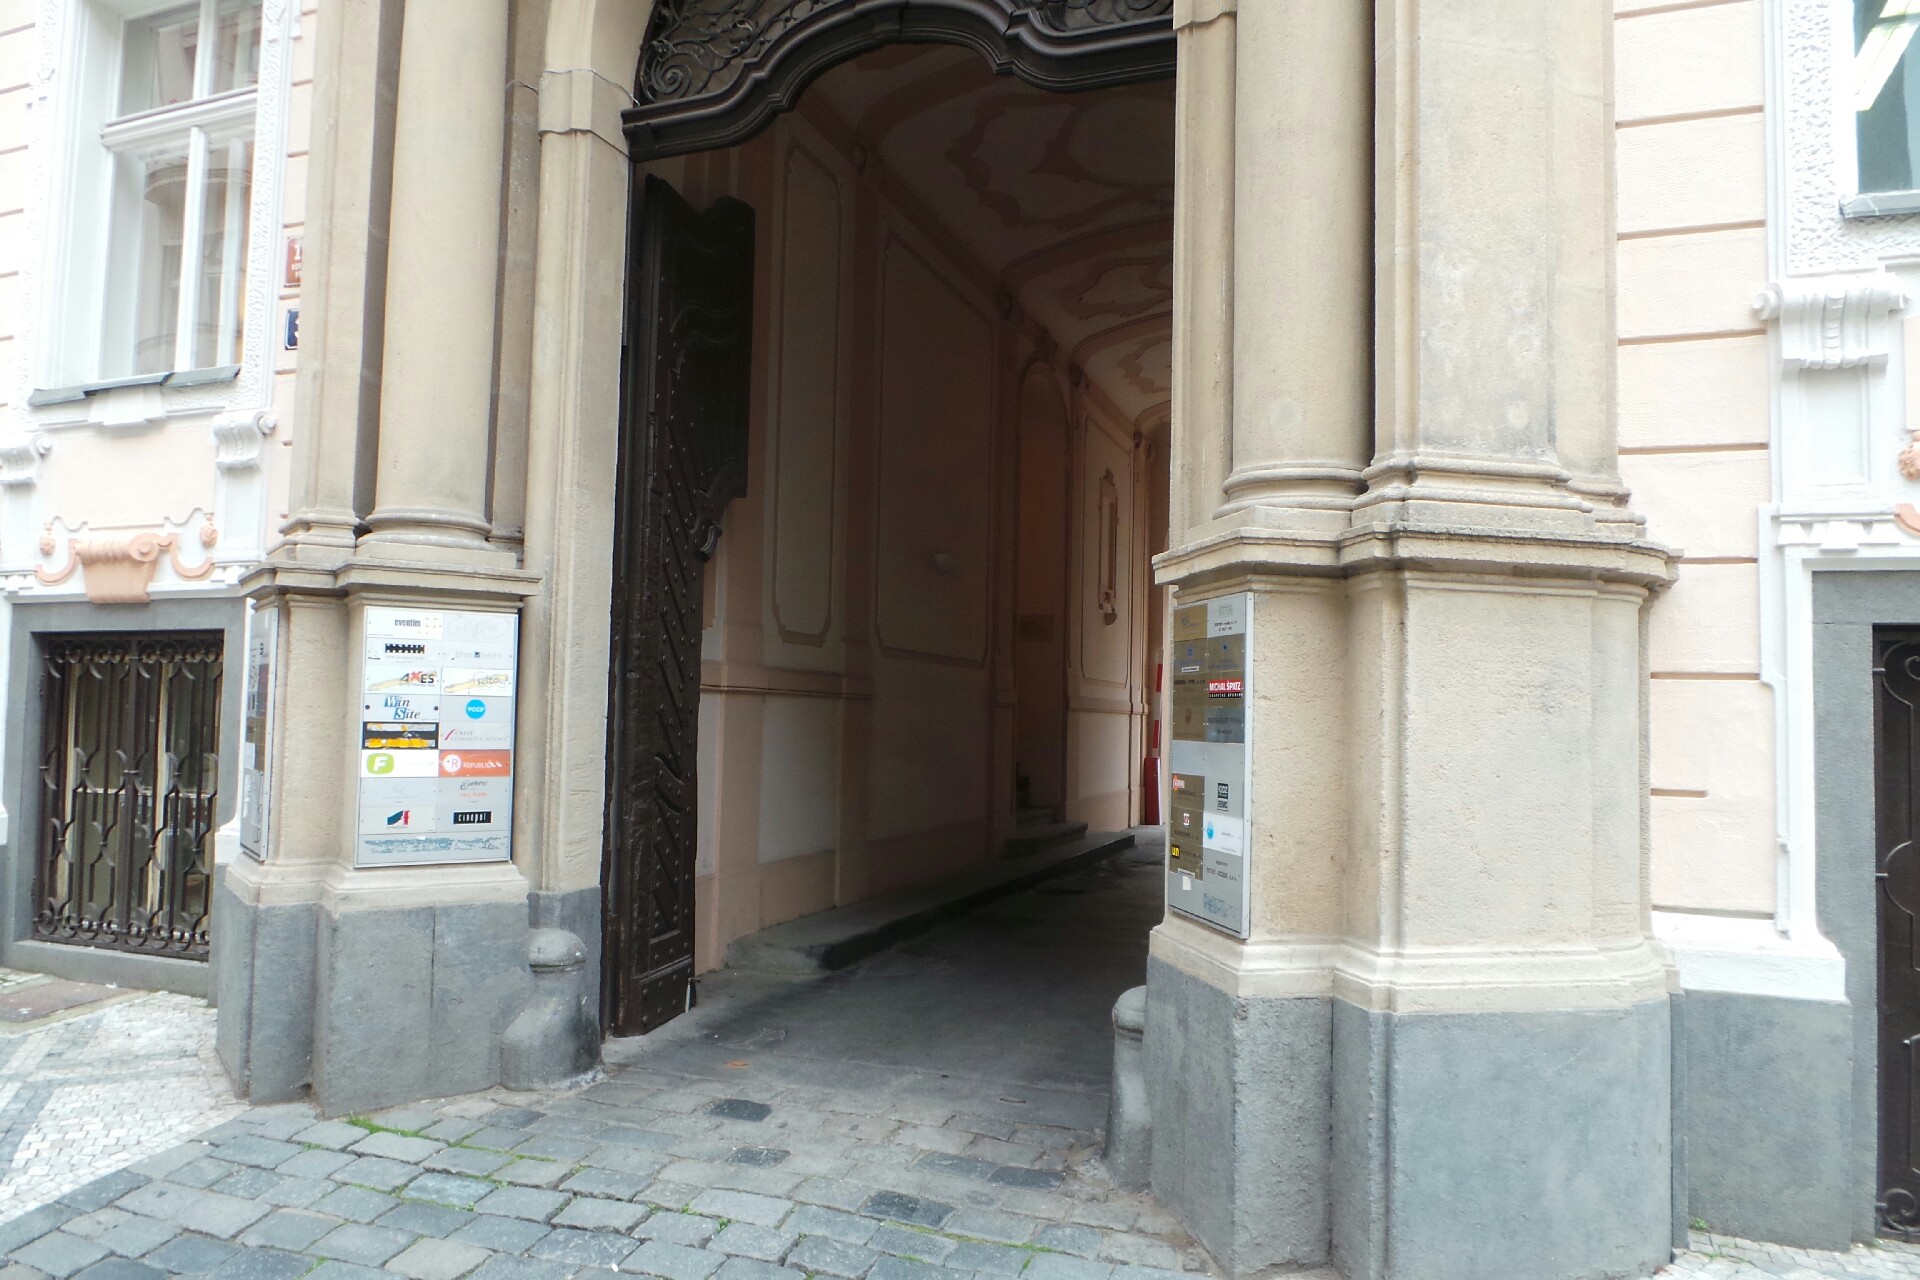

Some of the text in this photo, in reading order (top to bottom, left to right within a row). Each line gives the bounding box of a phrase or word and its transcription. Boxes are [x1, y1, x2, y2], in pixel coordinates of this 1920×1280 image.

[394, 618, 421, 627] eventim
[400, 671, 435, 684] AXES
[1209, 682, 1226, 691] MICHAL
[384, 695, 410, 707] Win
[393, 707, 421, 720] Site
